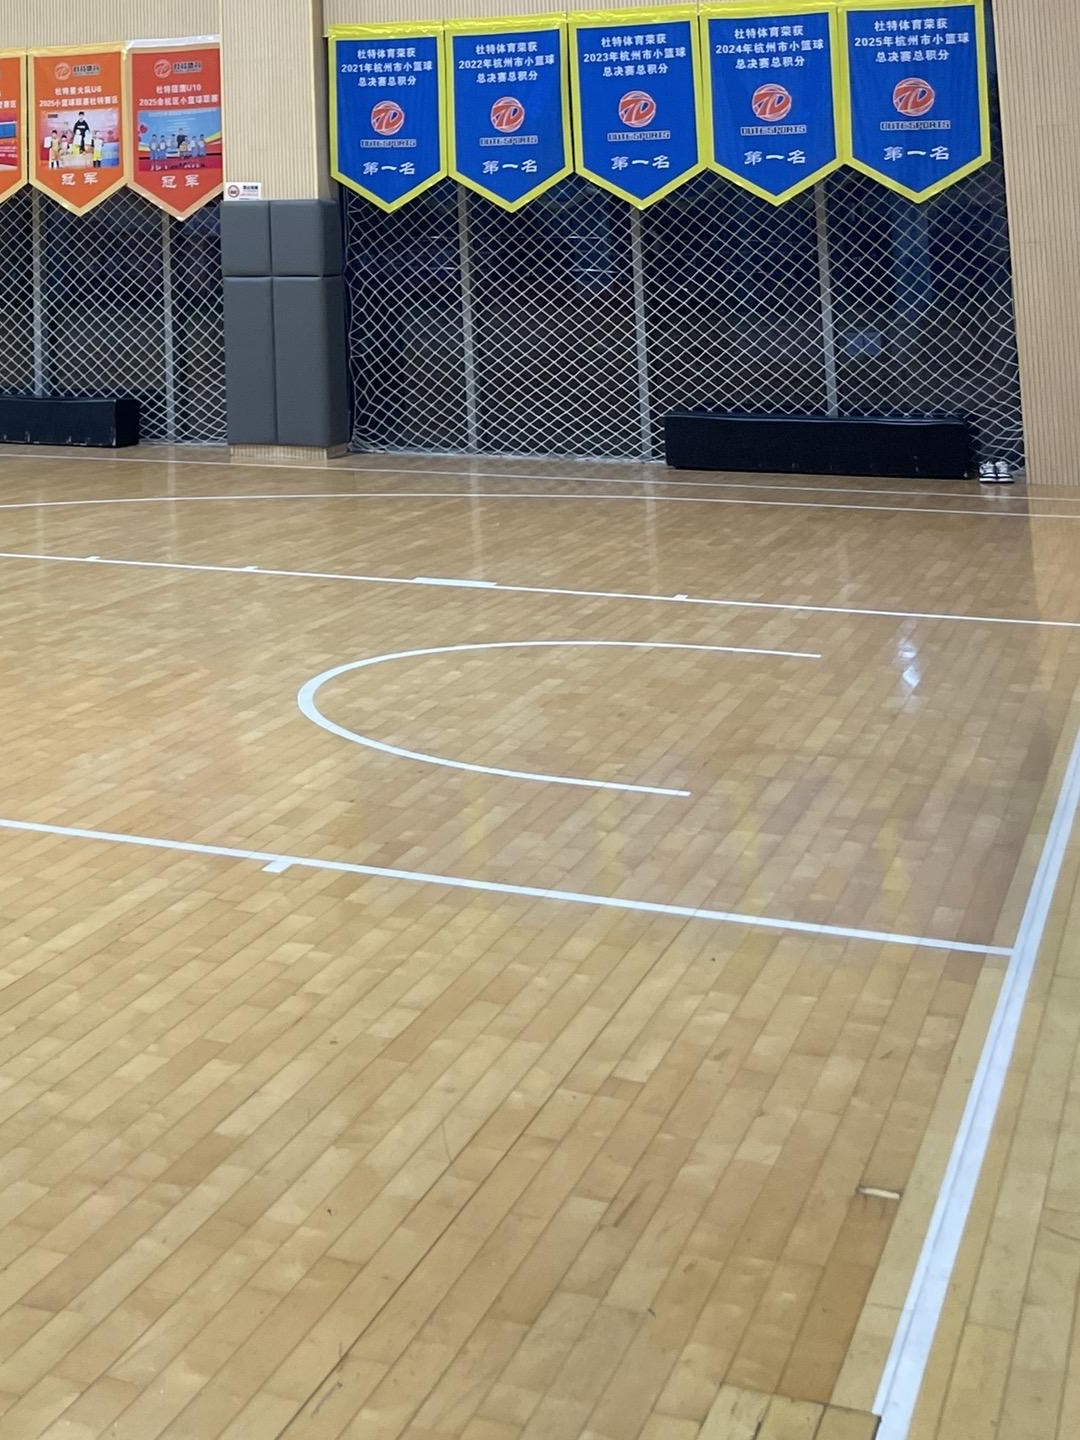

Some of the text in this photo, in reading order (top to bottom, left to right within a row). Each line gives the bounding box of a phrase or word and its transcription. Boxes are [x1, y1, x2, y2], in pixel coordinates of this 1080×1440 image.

[734, 25, 804, 40] 杜特体育荣获
[874, 18, 949, 32] 杜特体育荣获
[601, 33, 667, 48] 杜特体育荣获
[715, 38, 824, 55] 2024年杭州市小篮球
[854, 32, 969, 47] 2025年杭州市小篮球
[357, 47, 416, 60] 杜特体育荣获
[475, 41, 538, 55] 杜特体育荣获
[583, 46, 687, 63] 2023年杭州市小篮球
[458, 54, 555, 70] 2022年杭州市小篮球
[735, 56, 805, 70] 总决赛总积分
[875, 49, 950, 63] 总决赛总积分
[341, 60, 433, 74] 2021年杭州市小篮球
[602, 62, 669, 78] 总决赛总积分
[358, 75, 416, 88] 总决赛总积分
[476, 70, 538, 84] 总决赛总积分
[743, 149, 807, 166] 第一名
[883, 145, 950, 161] 第一名
[362, 160, 416, 176] 第一名
[482, 159, 538, 175] 第一名
[610, 154, 670, 171] 第一名
[61, 172, 99, 185] 冠军
[161, 175, 200, 188] 冠军
